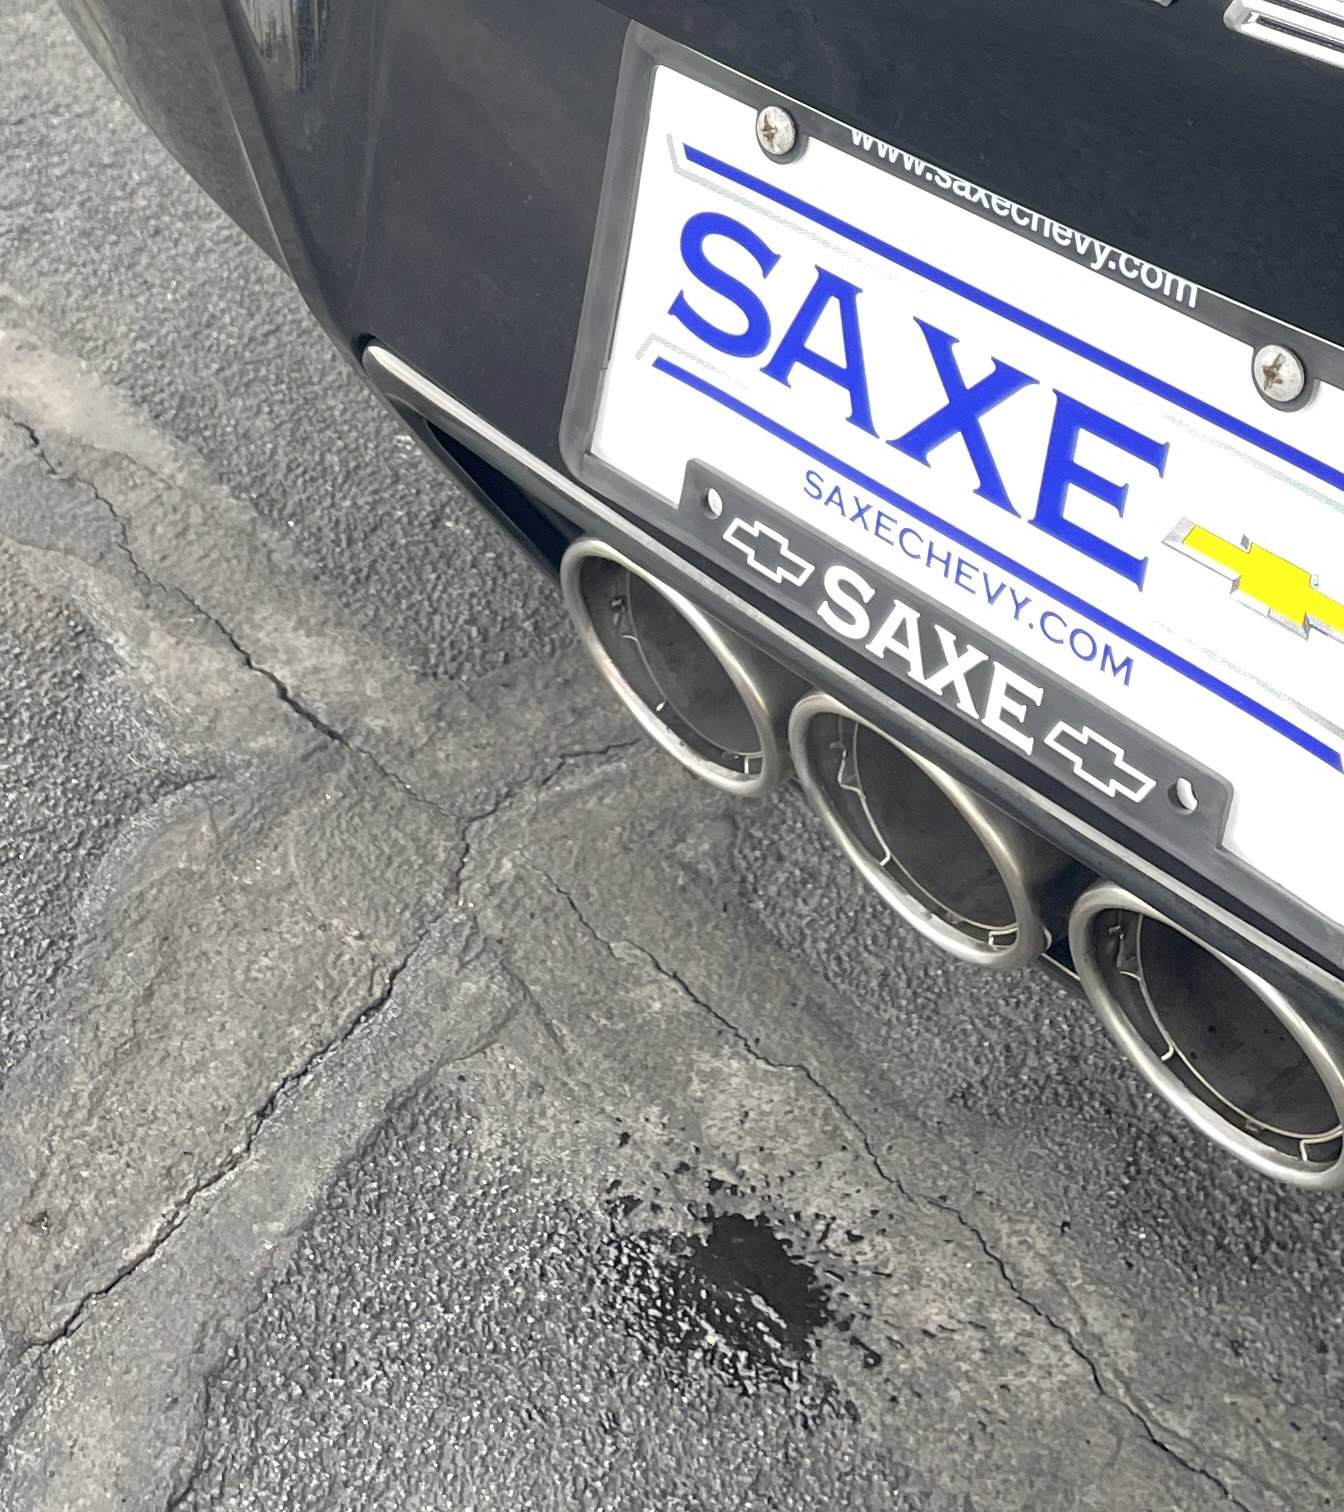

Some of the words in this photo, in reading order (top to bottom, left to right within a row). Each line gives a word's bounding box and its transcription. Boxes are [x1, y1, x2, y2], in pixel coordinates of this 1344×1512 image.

[668, 211, 1169, 592] SAXE
[803, 469, 1135, 687] SAXECHEVY.COM
[816, 564, 1044, 756] SAXE
